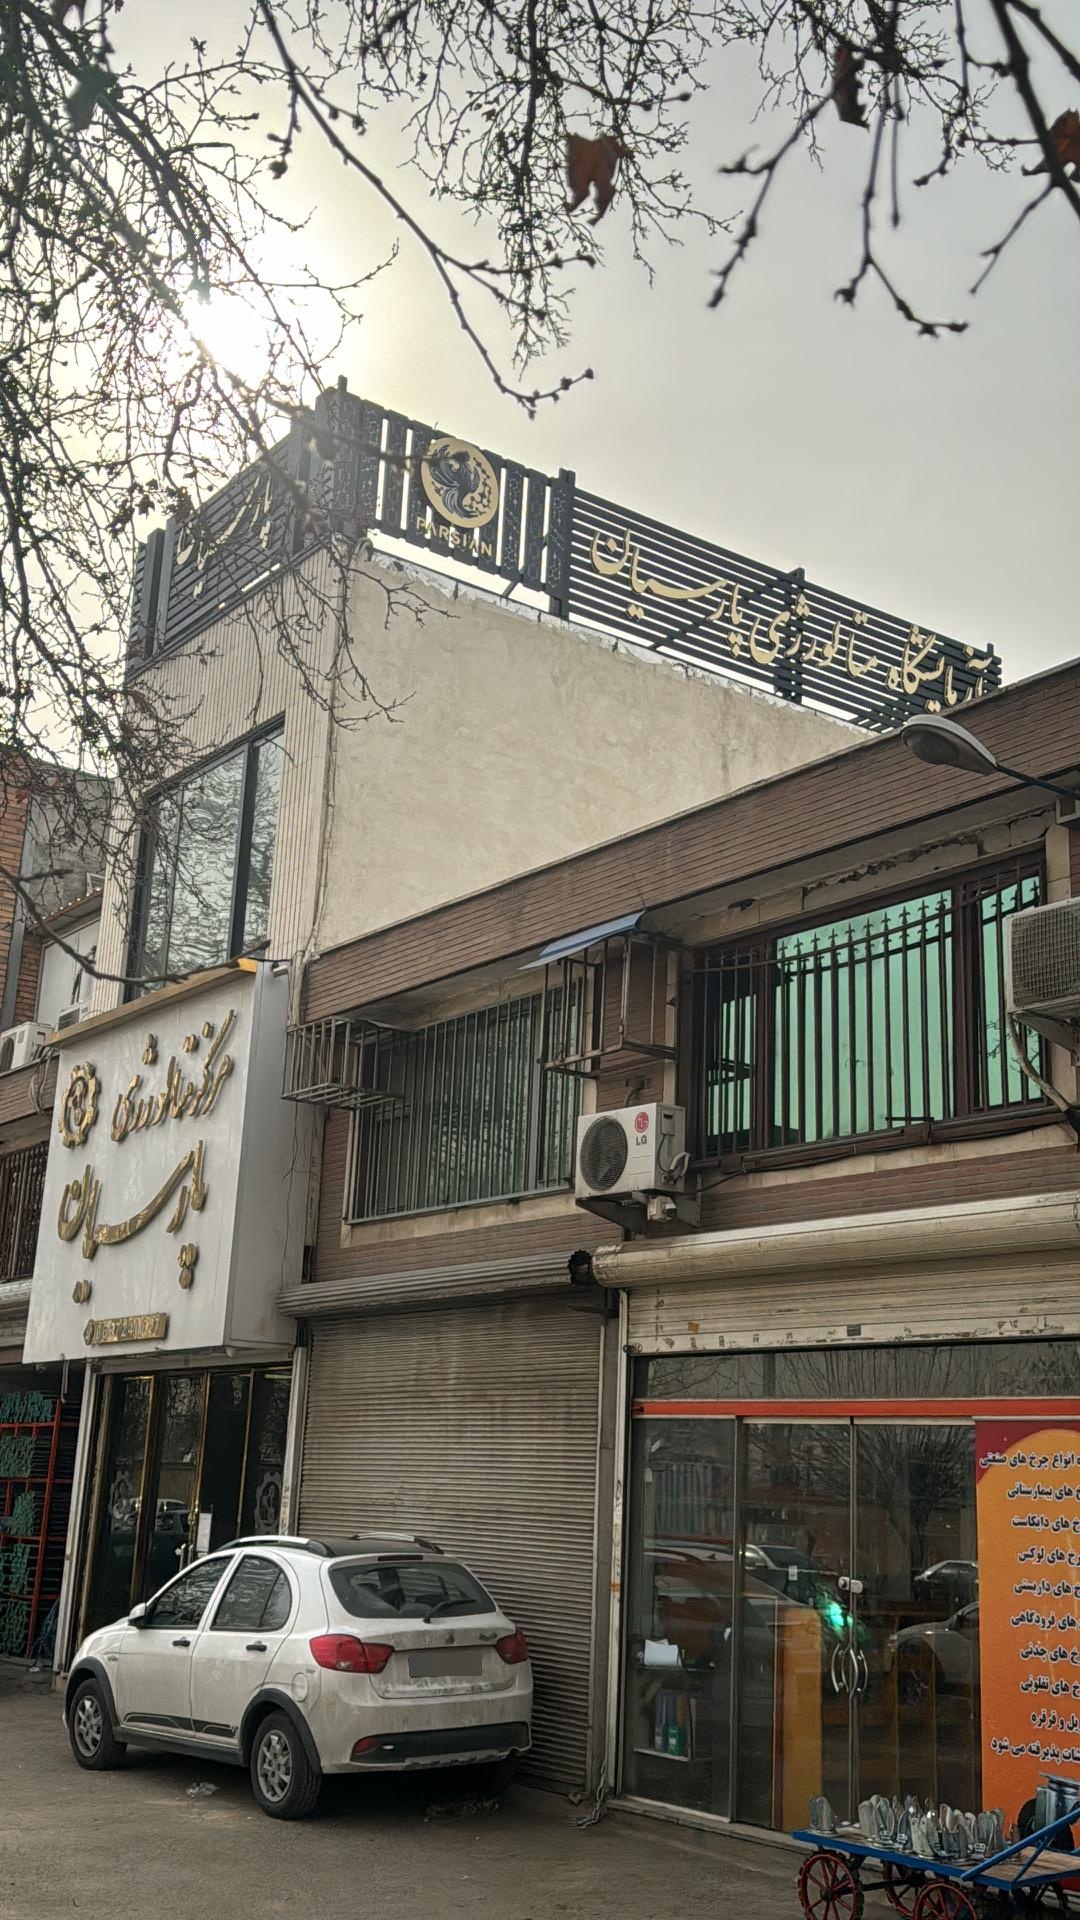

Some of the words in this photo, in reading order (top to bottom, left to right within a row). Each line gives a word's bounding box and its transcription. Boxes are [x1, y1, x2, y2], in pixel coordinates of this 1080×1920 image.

[415, 515, 494, 558] PARSIAN
[591, 528, 743, 658] پارسیان
[747, 592, 878, 678] متالورژی
[111, 1033, 200, 1142] متالورژی
[636, 1135, 647, 1145] LG
[57, 1140, 206, 1303] پارسیان
[980, 1451, 1007, 1468] صنعتی
[1009, 1450, 1027, 1468] های
[1028, 1452, 1049, 1470] چرخ
[1052, 1452, 1075, 1469] انواع
[1007, 1482, 1053, 1500] بیمارستانی
[1055, 1484, 1074, 1502] های
[1011, 1512, 1049, 1531] دایکاست
[1051, 1515, 1070, 1532] های
[1018, 1546, 1044, 1564] لوکس
[1046, 1546, 1065, 1565] های
[1014, 1578, 1051, 1597] داربستی
[1053, 1580, 1072, 1599] های
[1011, 1609, 1056, 1629] فرودگاهی
[1057, 1613, 1077, 1632] های
[1020, 1642, 1048, 1661] چدنی
[1049, 1645, 1068, 1663] های
[1020, 1673, 1049, 1696] تفلونی
[1051, 1677, 1070, 1697] های
[1058, 1718, 1065, 1732] و
[991, 1737, 1009, 1755] شود
[1011, 1744, 1026, 1758] می
